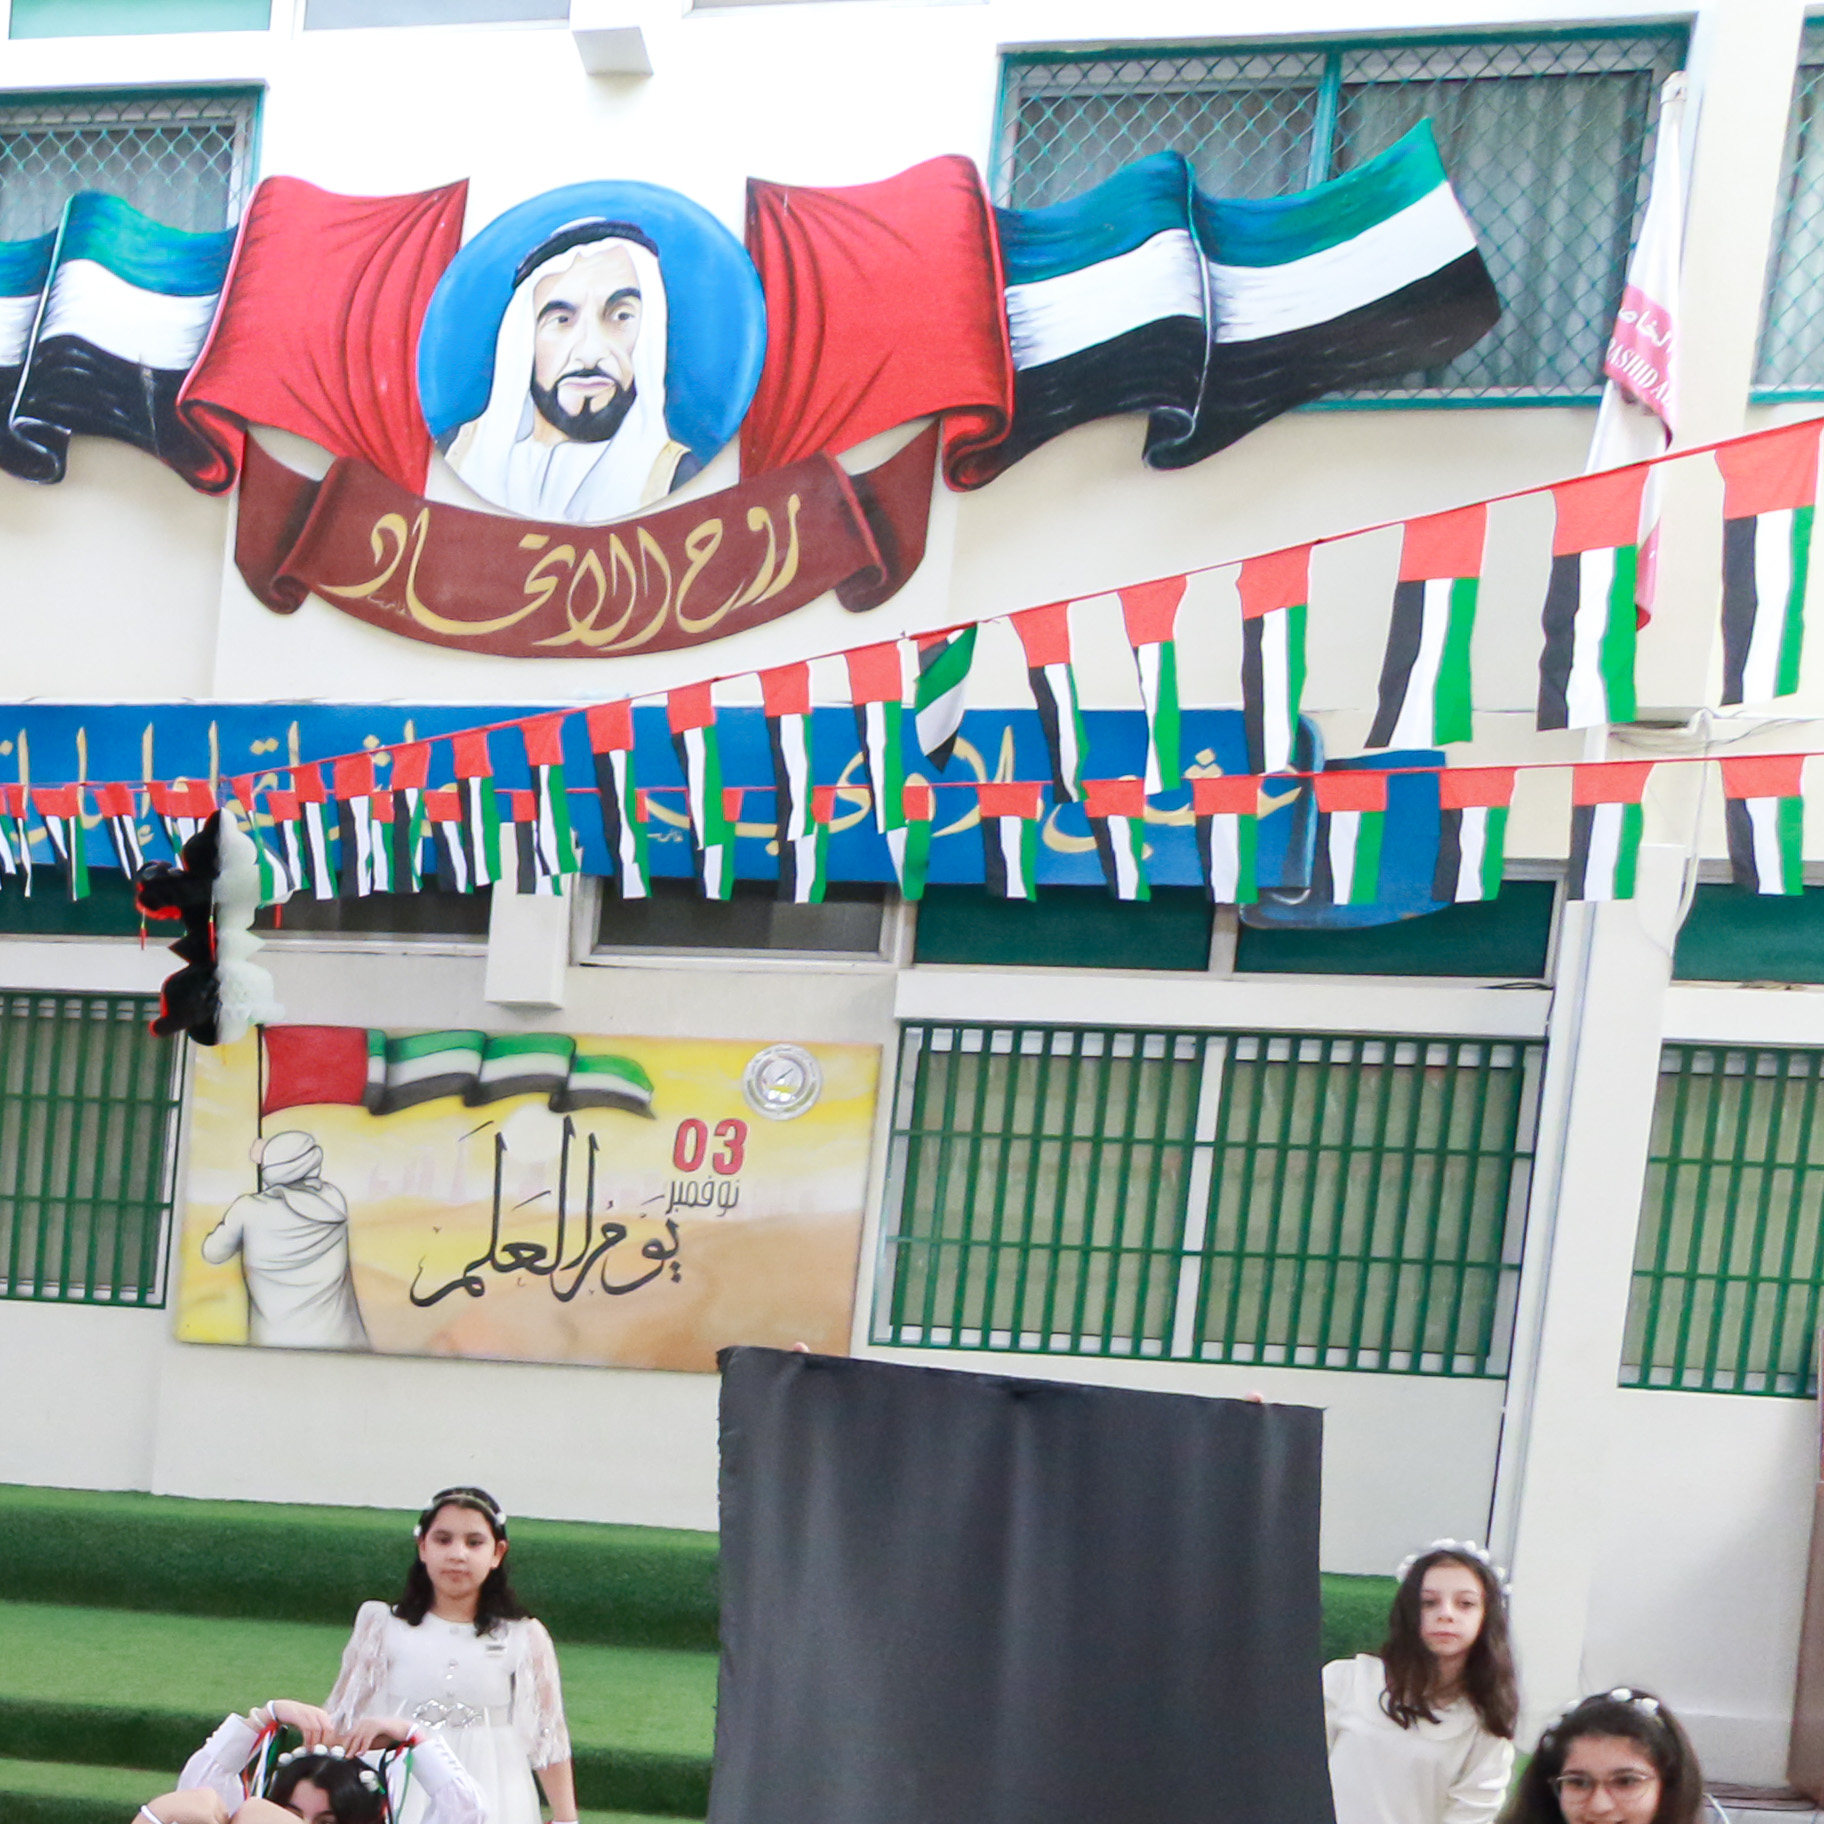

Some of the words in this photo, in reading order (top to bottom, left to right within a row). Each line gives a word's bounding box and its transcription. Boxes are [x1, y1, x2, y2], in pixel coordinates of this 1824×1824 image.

[676, 494, 801, 634] روح
[673, 1117, 748, 1176] 03
[664, 1175, 741, 1217] نوفمبر
